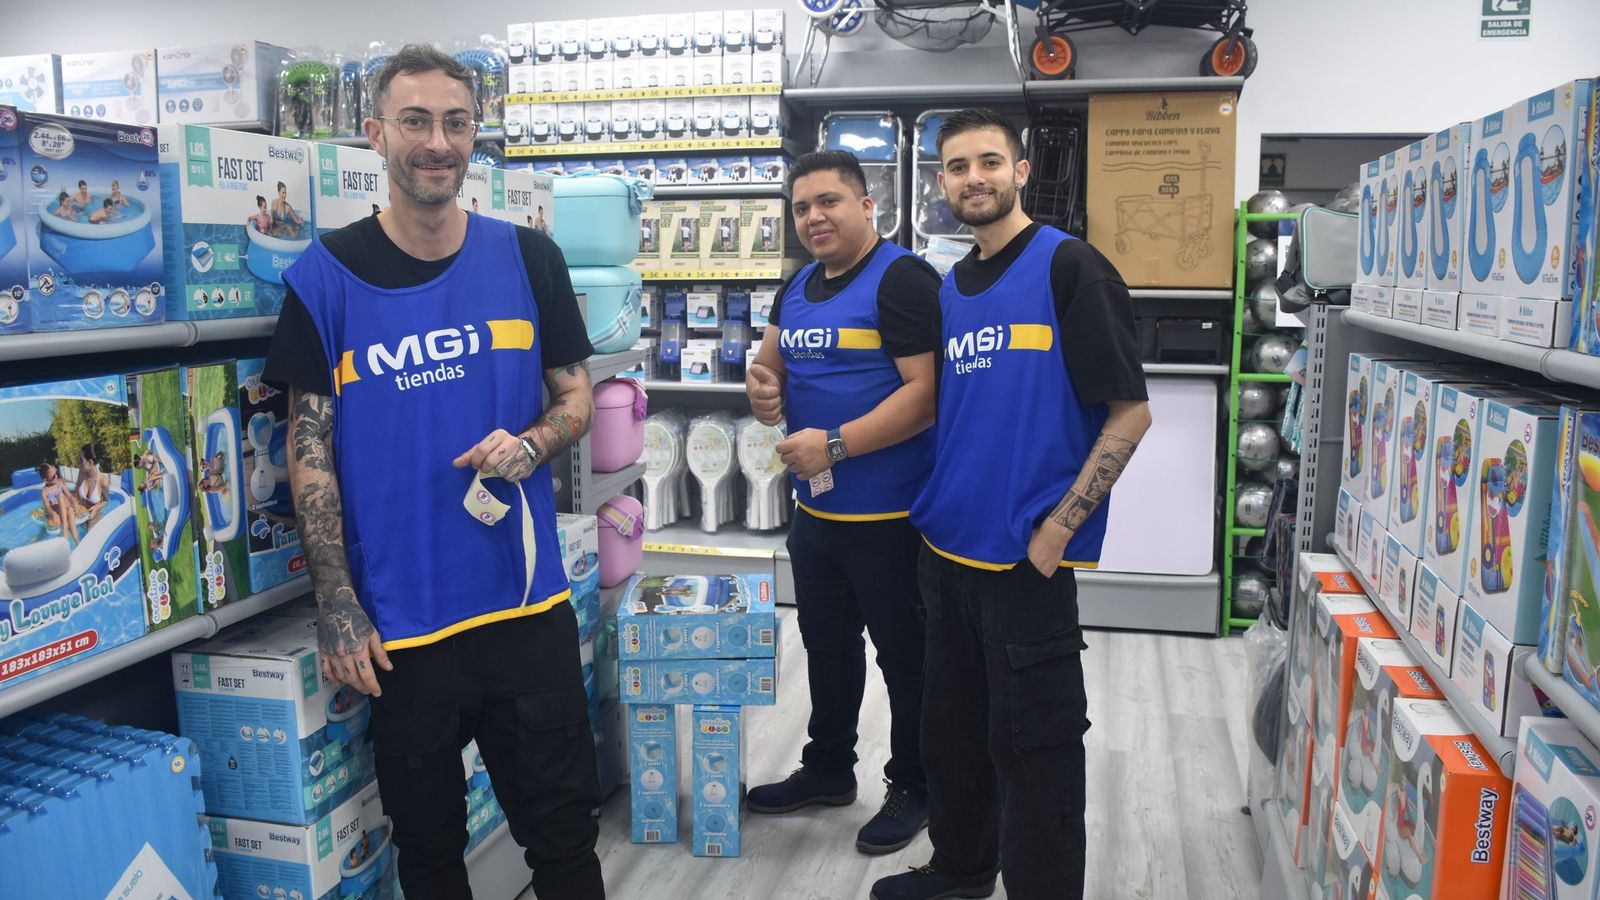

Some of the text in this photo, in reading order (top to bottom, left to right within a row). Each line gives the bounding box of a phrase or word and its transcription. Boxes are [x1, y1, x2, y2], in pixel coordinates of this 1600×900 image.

[159, 143, 169, 152] SET
[218, 157, 264, 182] FAST SET
[343, 170, 378, 192] FAST SET
[507, 189, 532, 206] FAST SET
[780, 328, 832, 348] MGi
[947, 325, 1004, 361] MGi
[367, 324, 480, 376] MGi
[395, 363, 465, 391] tiendas
[12, 574, 114, 630] Lounge Pool
[75, 636, 89, 647] cm
[218, 677, 245, 688] FAST SET
[252, 669, 285, 680] Bestway
[336, 818, 360, 843] FAST SET
[1472, 788, 1499, 862] Bestway
[235, 838, 262, 850] FAST SET
[269, 831, 300, 845] Bestway
